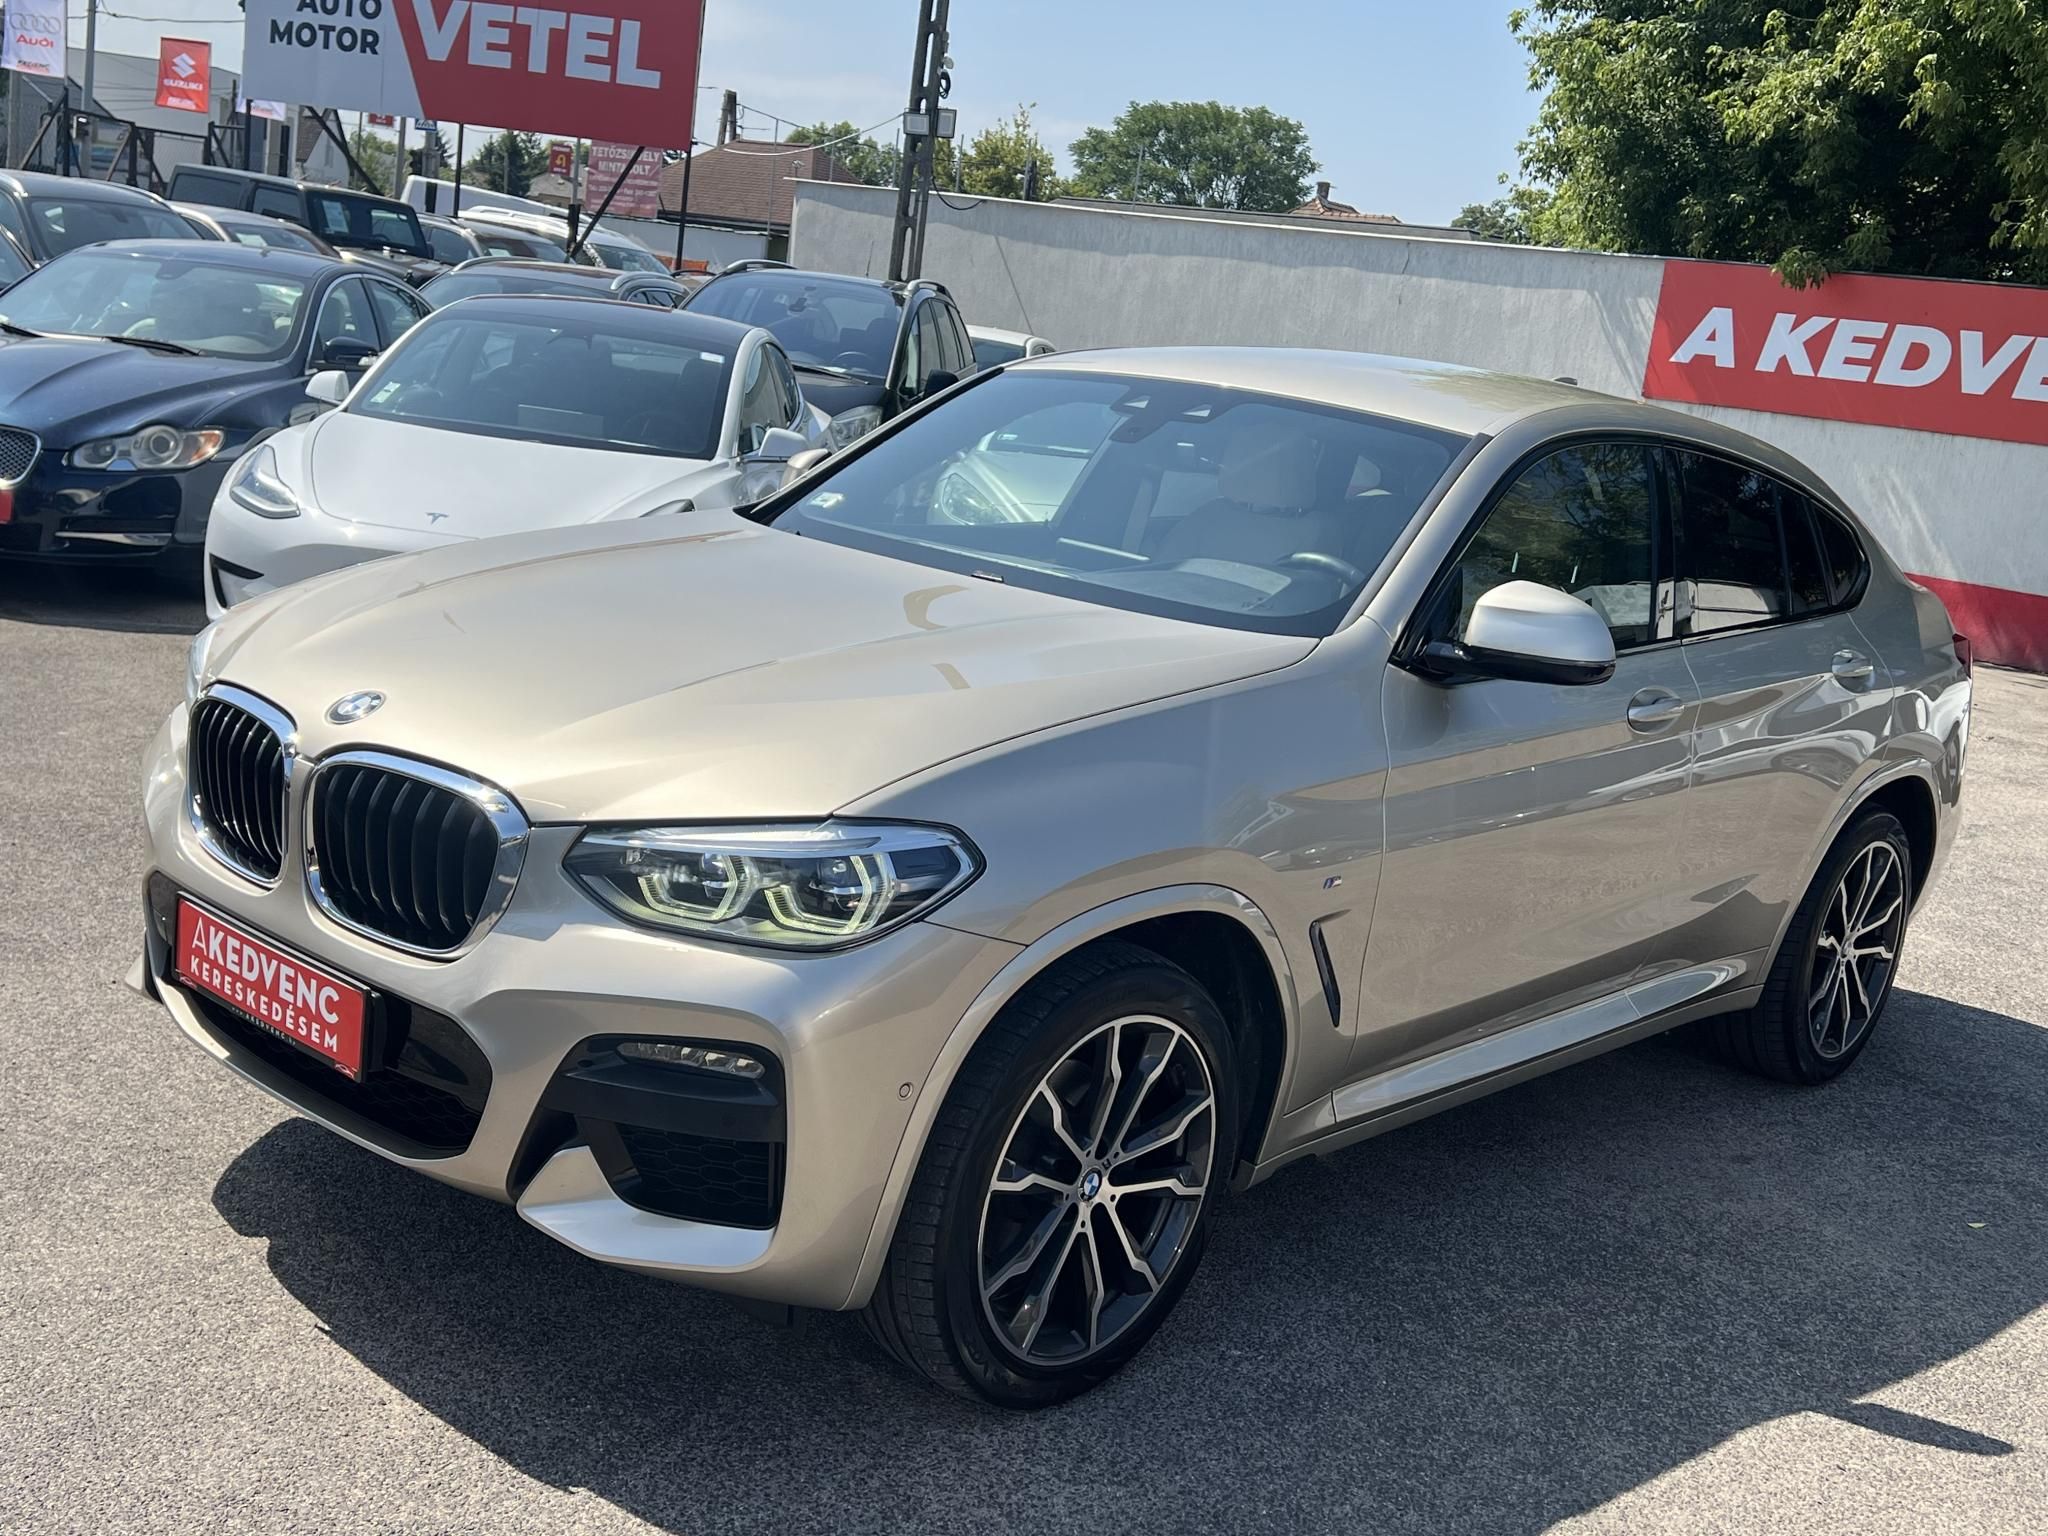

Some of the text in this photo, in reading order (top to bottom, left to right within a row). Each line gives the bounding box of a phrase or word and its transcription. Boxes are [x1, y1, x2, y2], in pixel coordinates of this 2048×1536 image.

[16, 34, 54, 48] Audi
[269, 19, 379, 55] MOTOR
[1669, 306, 1735, 368] A
[190, 955, 338, 1053] KERESKEDÉSEM
